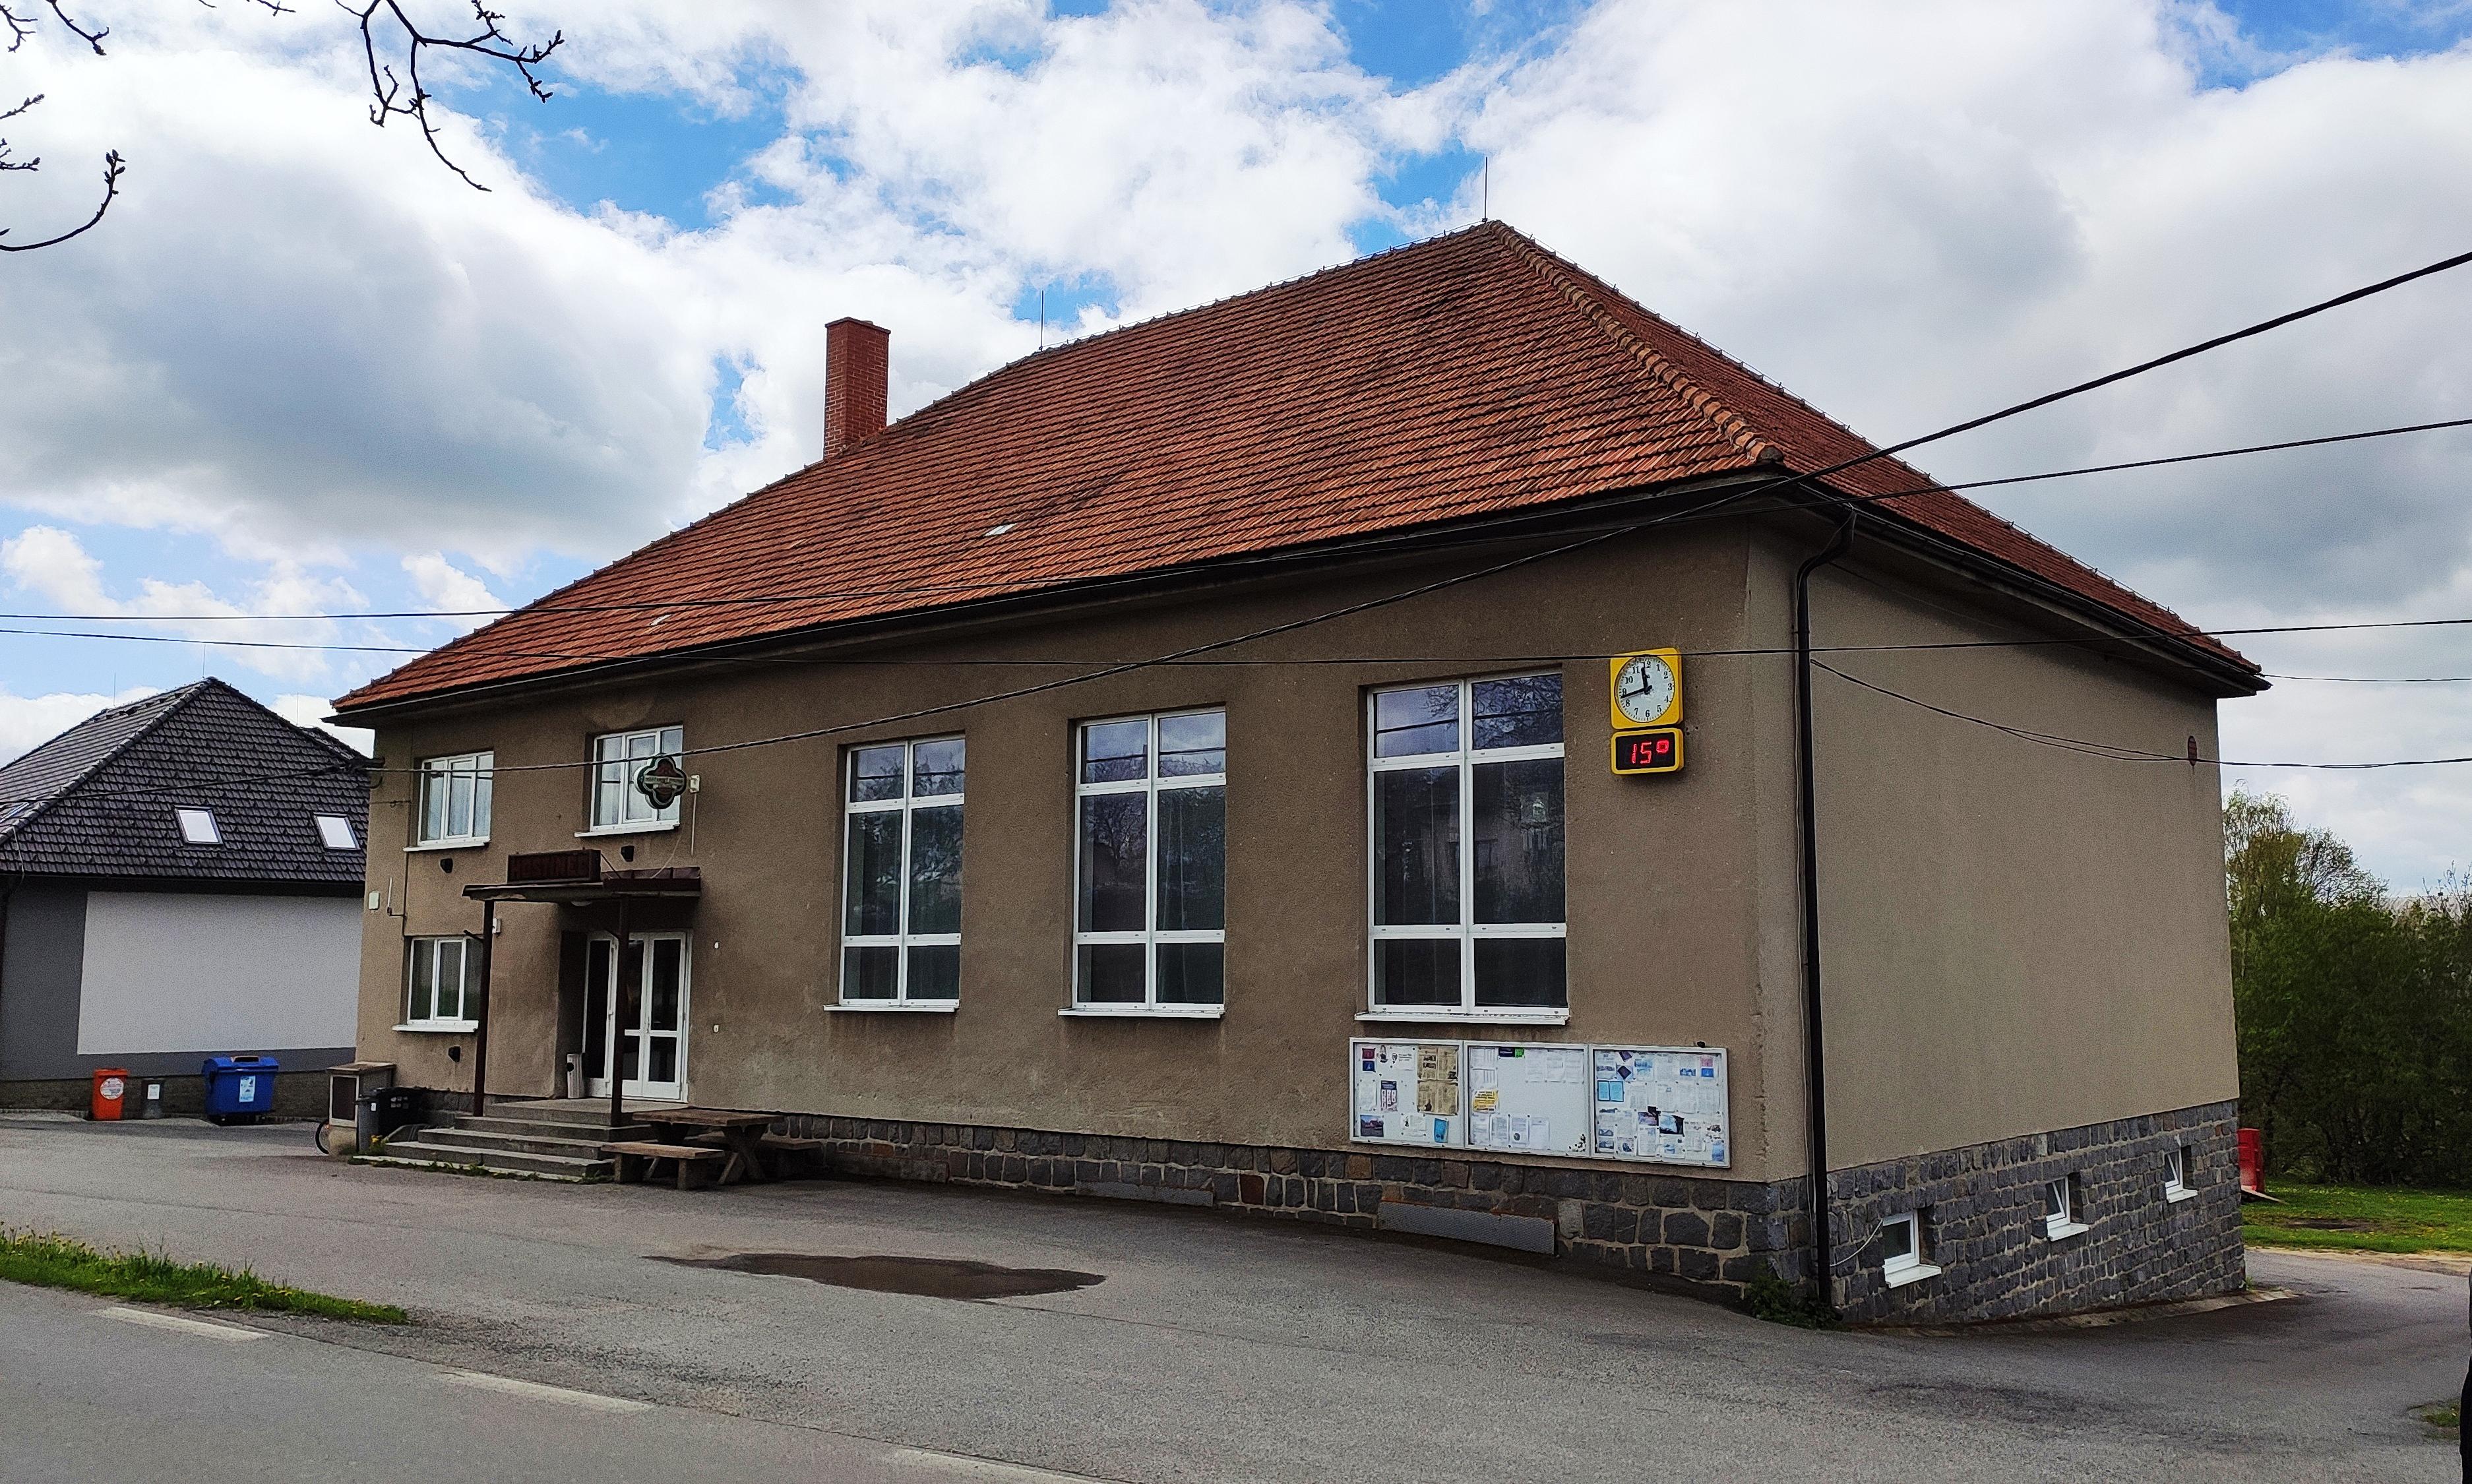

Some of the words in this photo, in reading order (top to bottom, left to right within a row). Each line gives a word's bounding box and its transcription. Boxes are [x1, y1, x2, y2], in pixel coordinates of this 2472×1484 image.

[1632, 665, 1640, 674] 11
[1624, 676, 1634, 685] 10
[1622, 688, 1627, 696] 9
